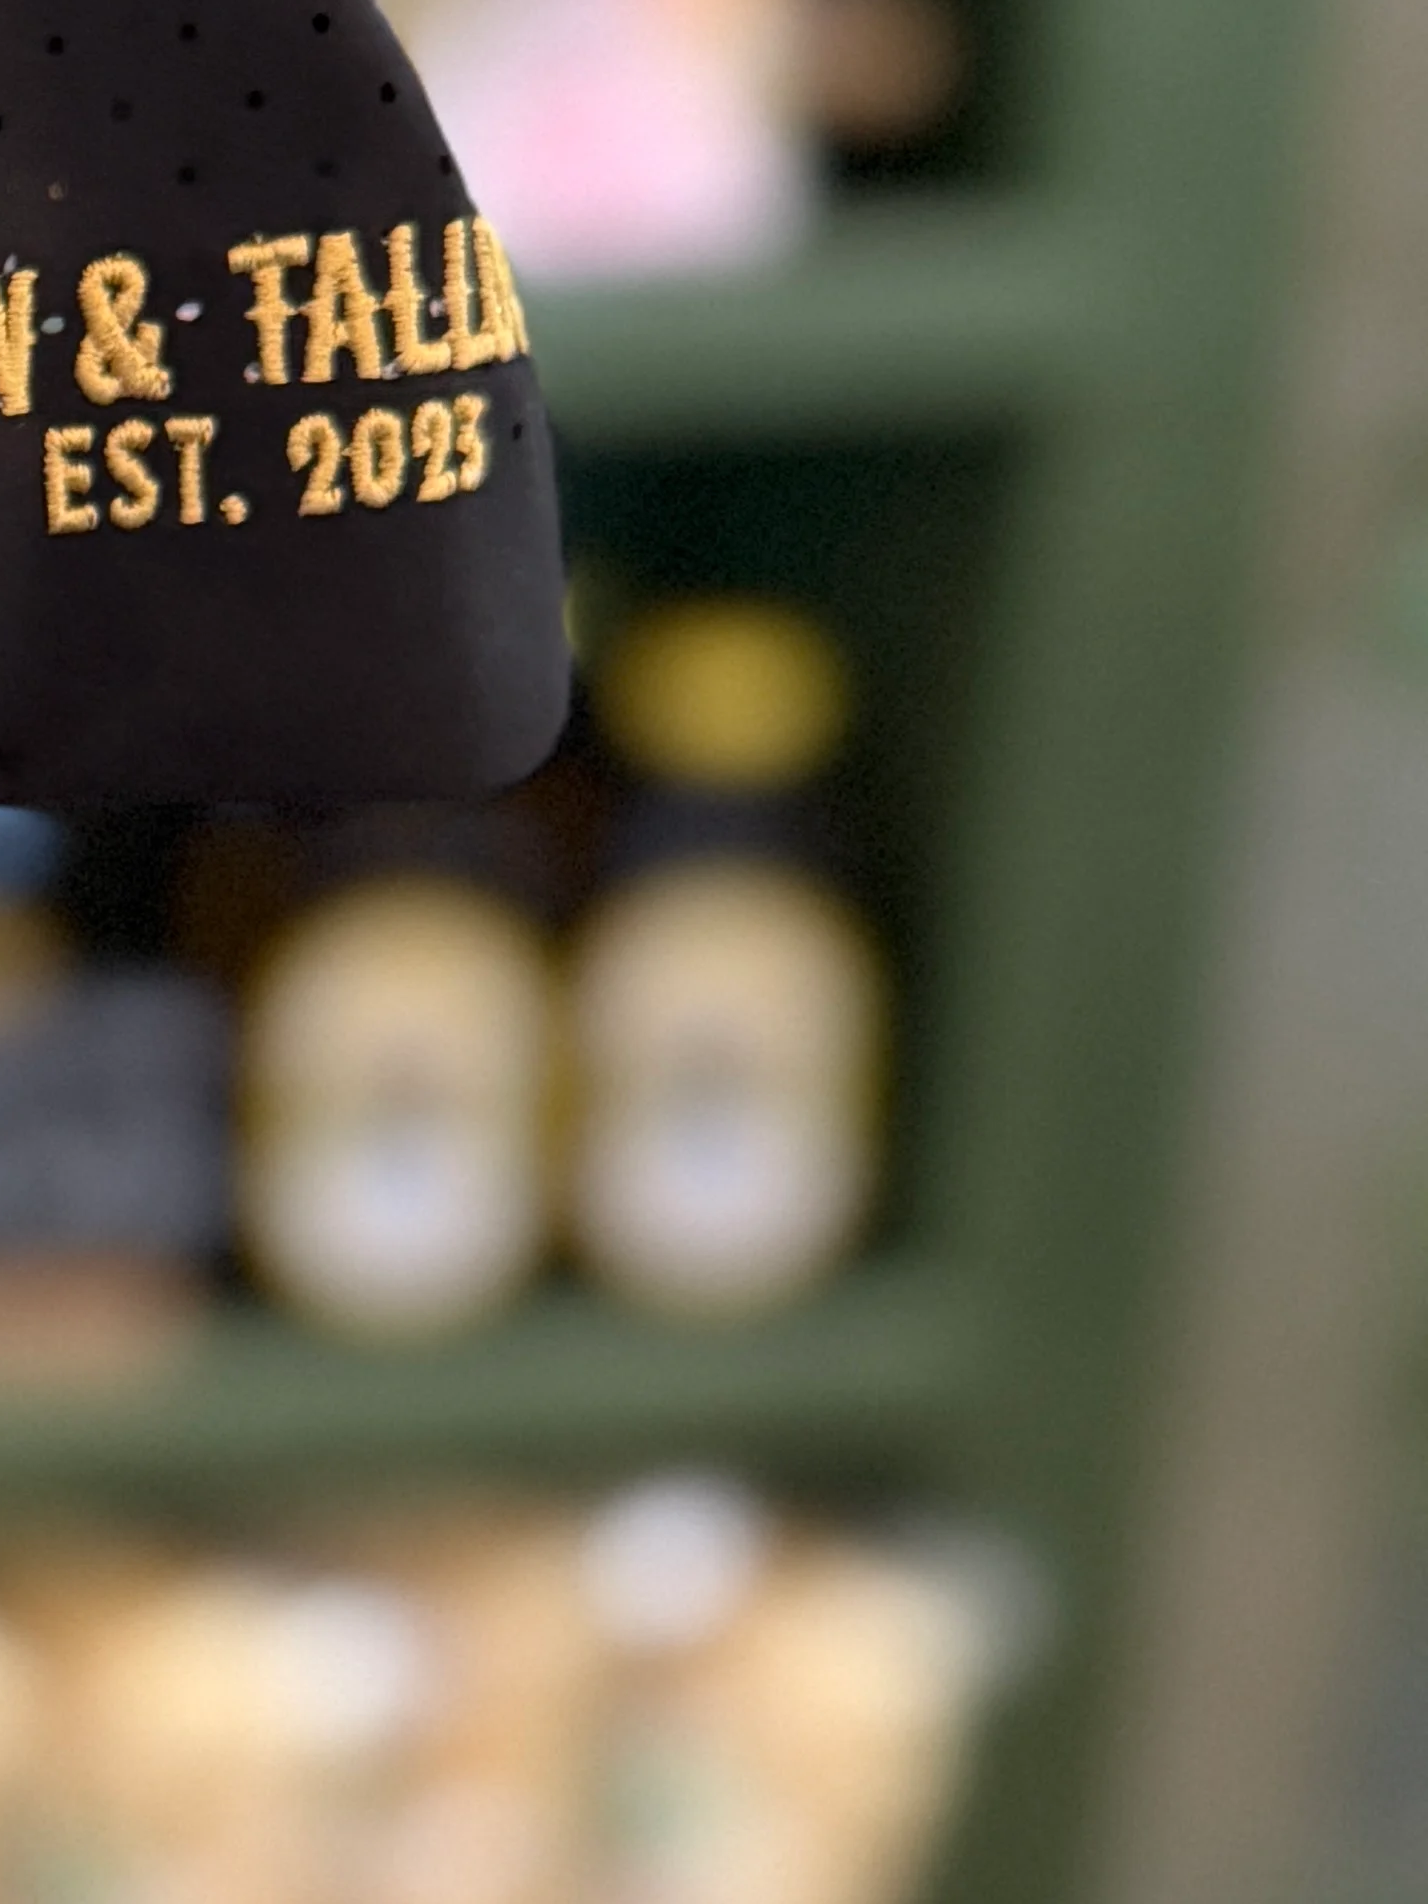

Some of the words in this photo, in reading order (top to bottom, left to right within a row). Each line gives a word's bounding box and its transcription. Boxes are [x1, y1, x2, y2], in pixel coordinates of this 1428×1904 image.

[76, 252, 171, 405] &
[44, 418, 248, 535] EST.
[287, 394, 489, 517] 2023
